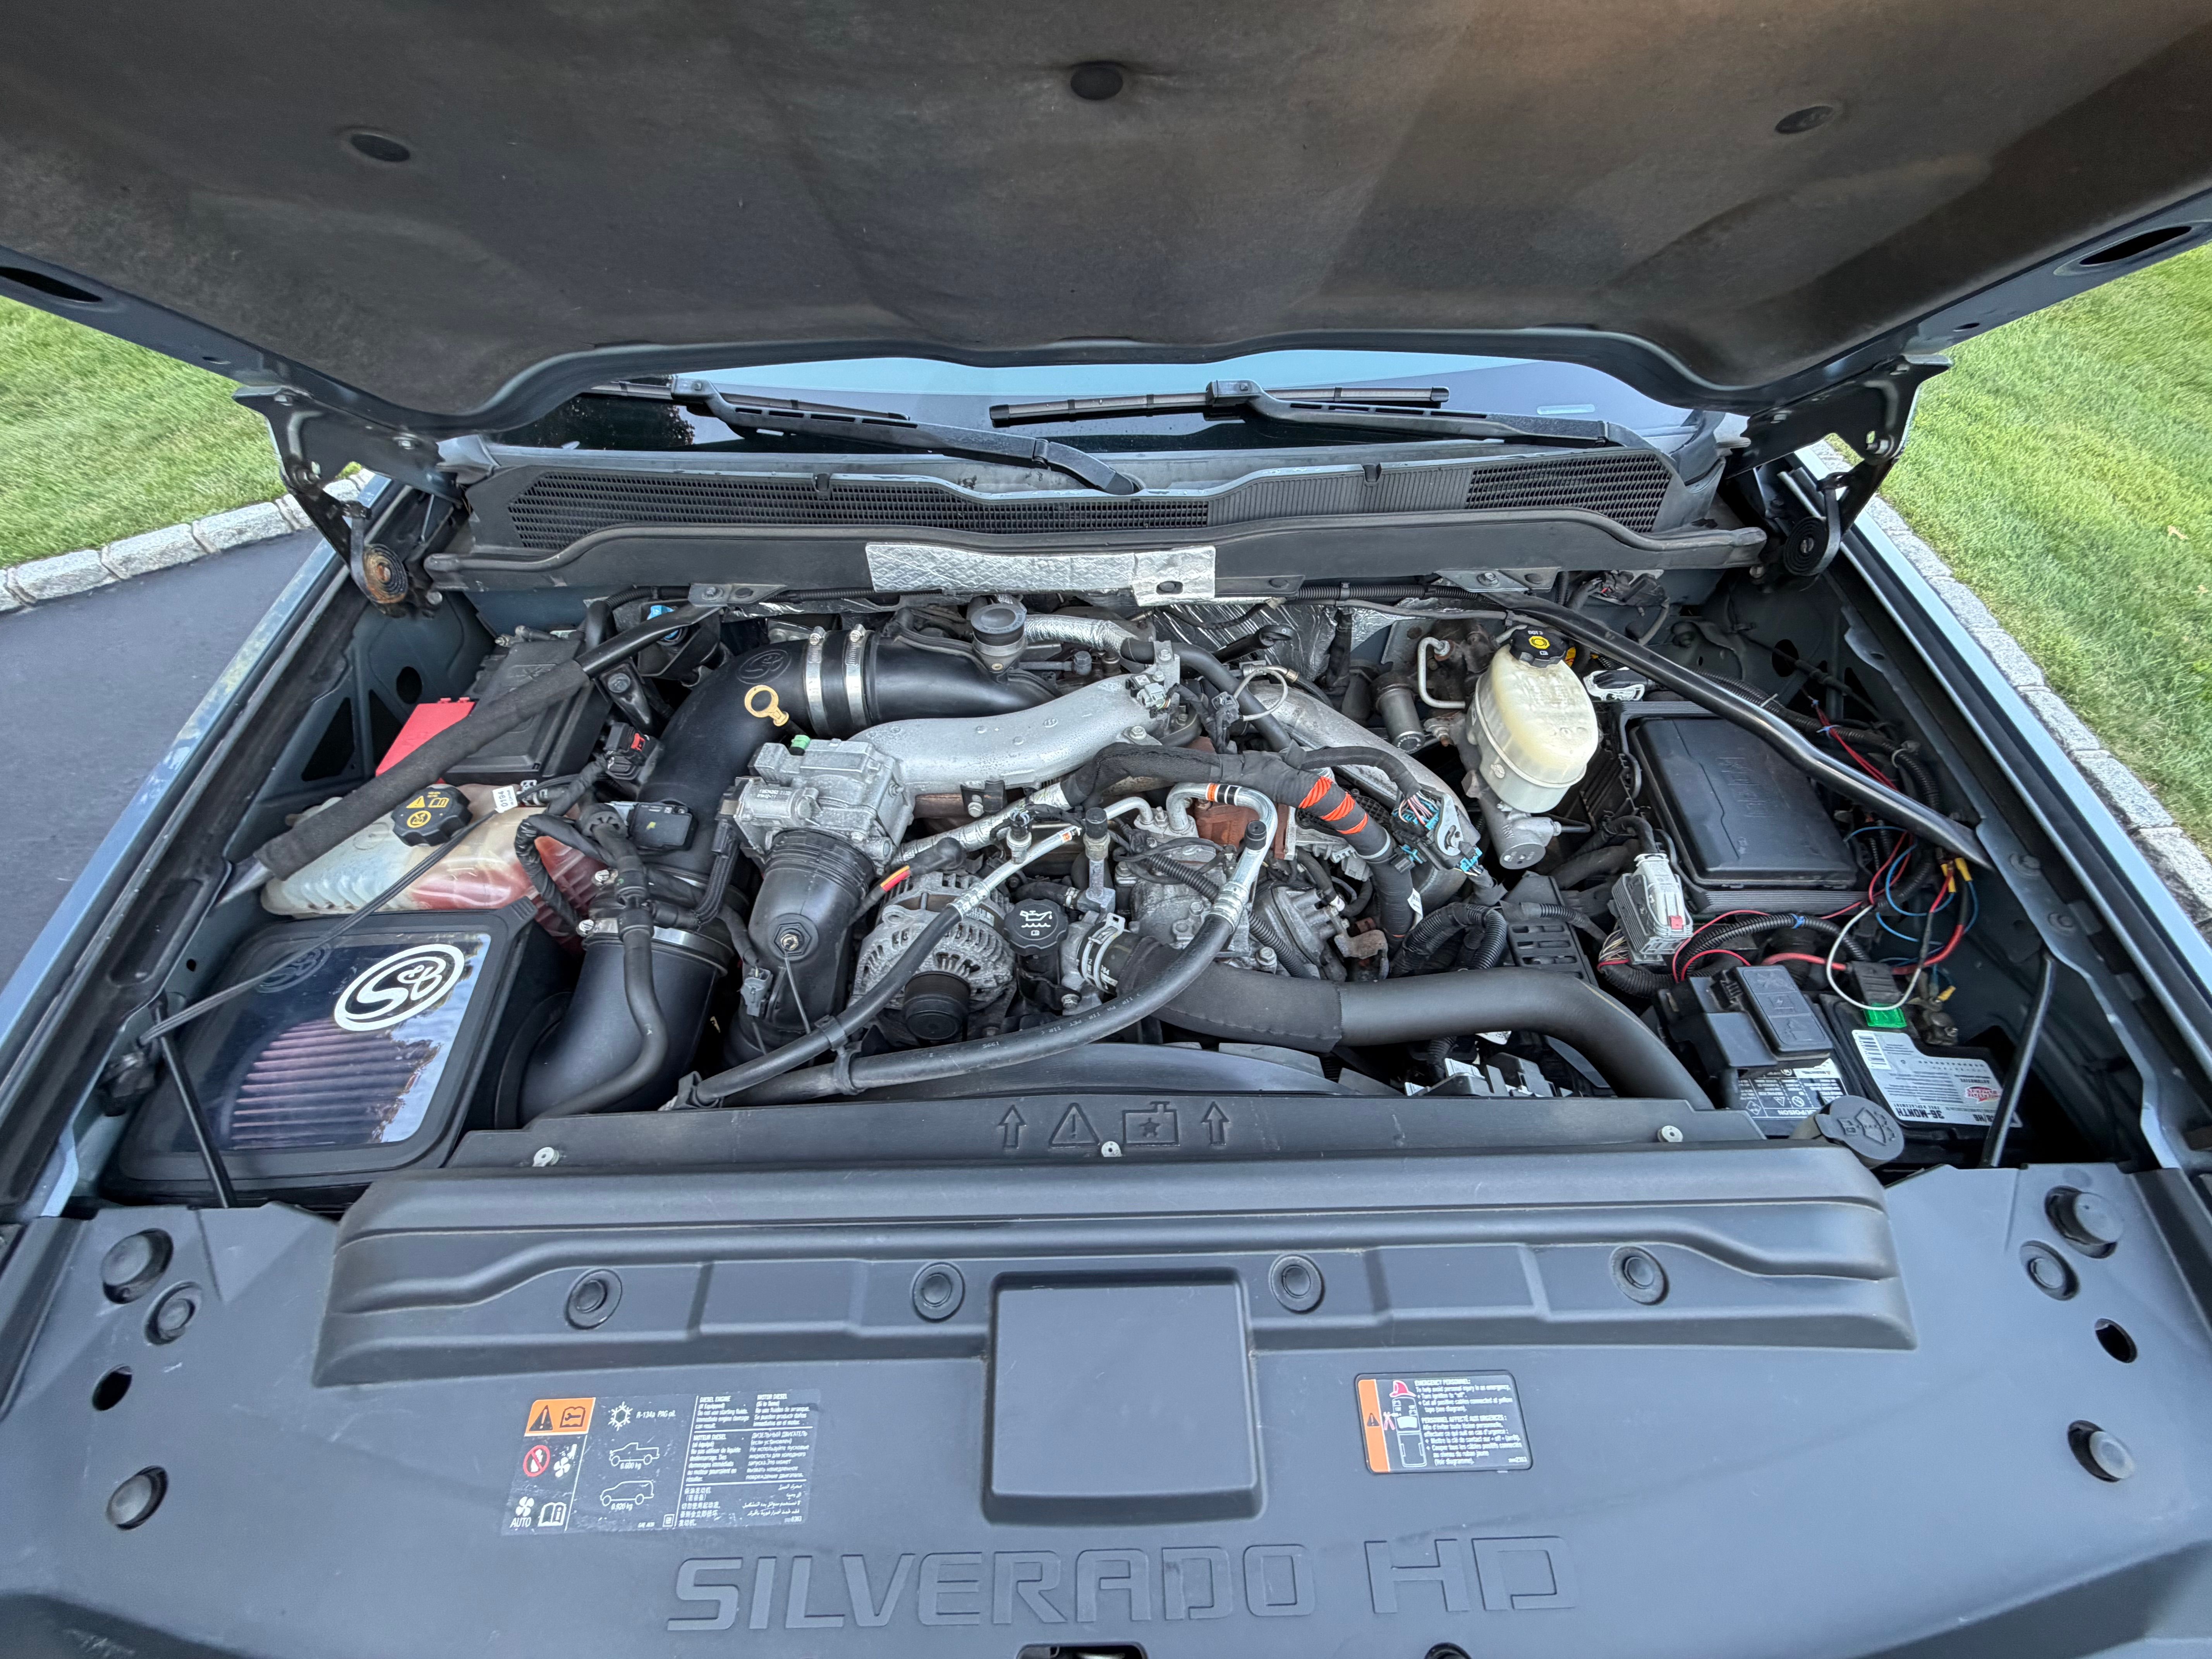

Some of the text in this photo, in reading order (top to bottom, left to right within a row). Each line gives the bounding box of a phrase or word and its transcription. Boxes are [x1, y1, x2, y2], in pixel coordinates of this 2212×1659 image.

[342, 953, 452, 1022] S&B
[1895, 1108, 1945, 1119] 36-MONTH
[1973, 1114, 1994, 1123] 8/H6
[626, 1503, 633, 1511] kg
[510, 1517, 531, 1528] AUTO
[667, 1535, 1579, 1631] SILVERADO HD
